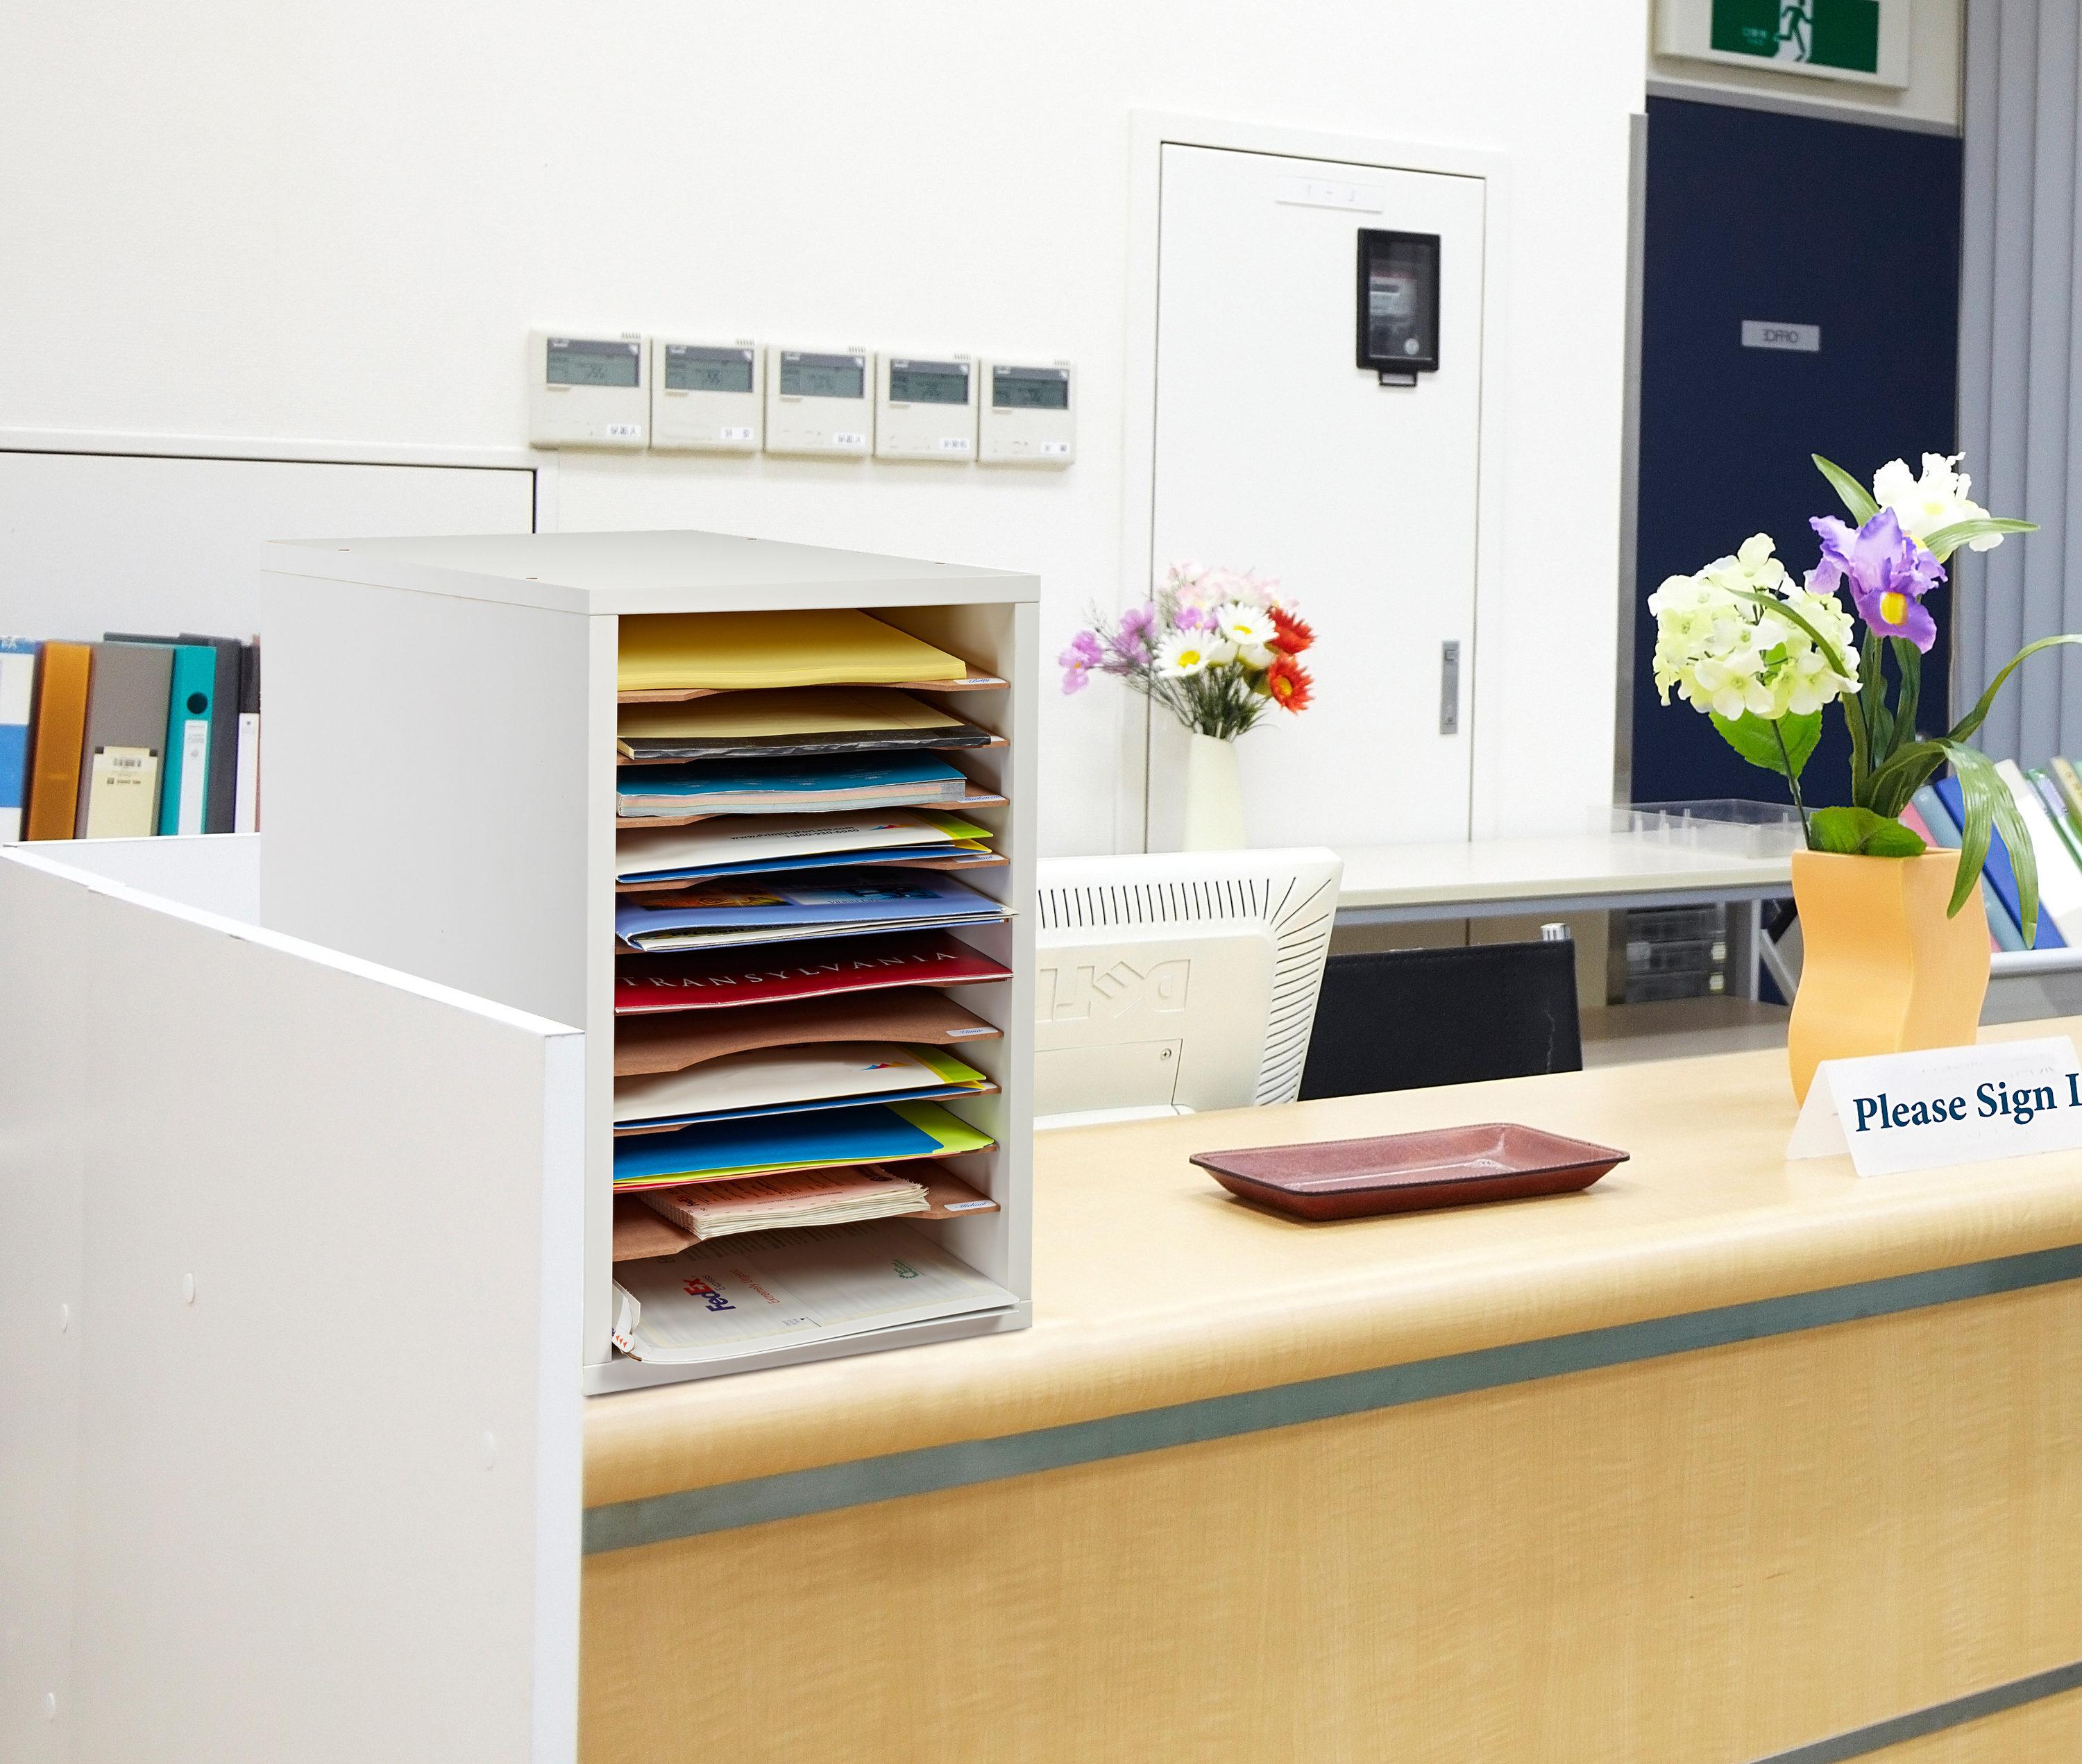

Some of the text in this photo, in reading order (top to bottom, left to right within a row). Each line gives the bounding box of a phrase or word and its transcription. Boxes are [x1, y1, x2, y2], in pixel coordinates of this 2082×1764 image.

[729, 826, 855, 840] www.PrintingForLess.com
[784, 829, 860, 839] 1-800-930-6040
[615, 951, 959, 987] TRANSYLVANIA
[1852, 1093, 1967, 1133] Please
[1976, 1080, 2058, 1126] Sign
[702, 1273, 727, 1291] Express
[682, 1277, 736, 1312] FedEx
[752, 1283, 781, 1305] Extremely
